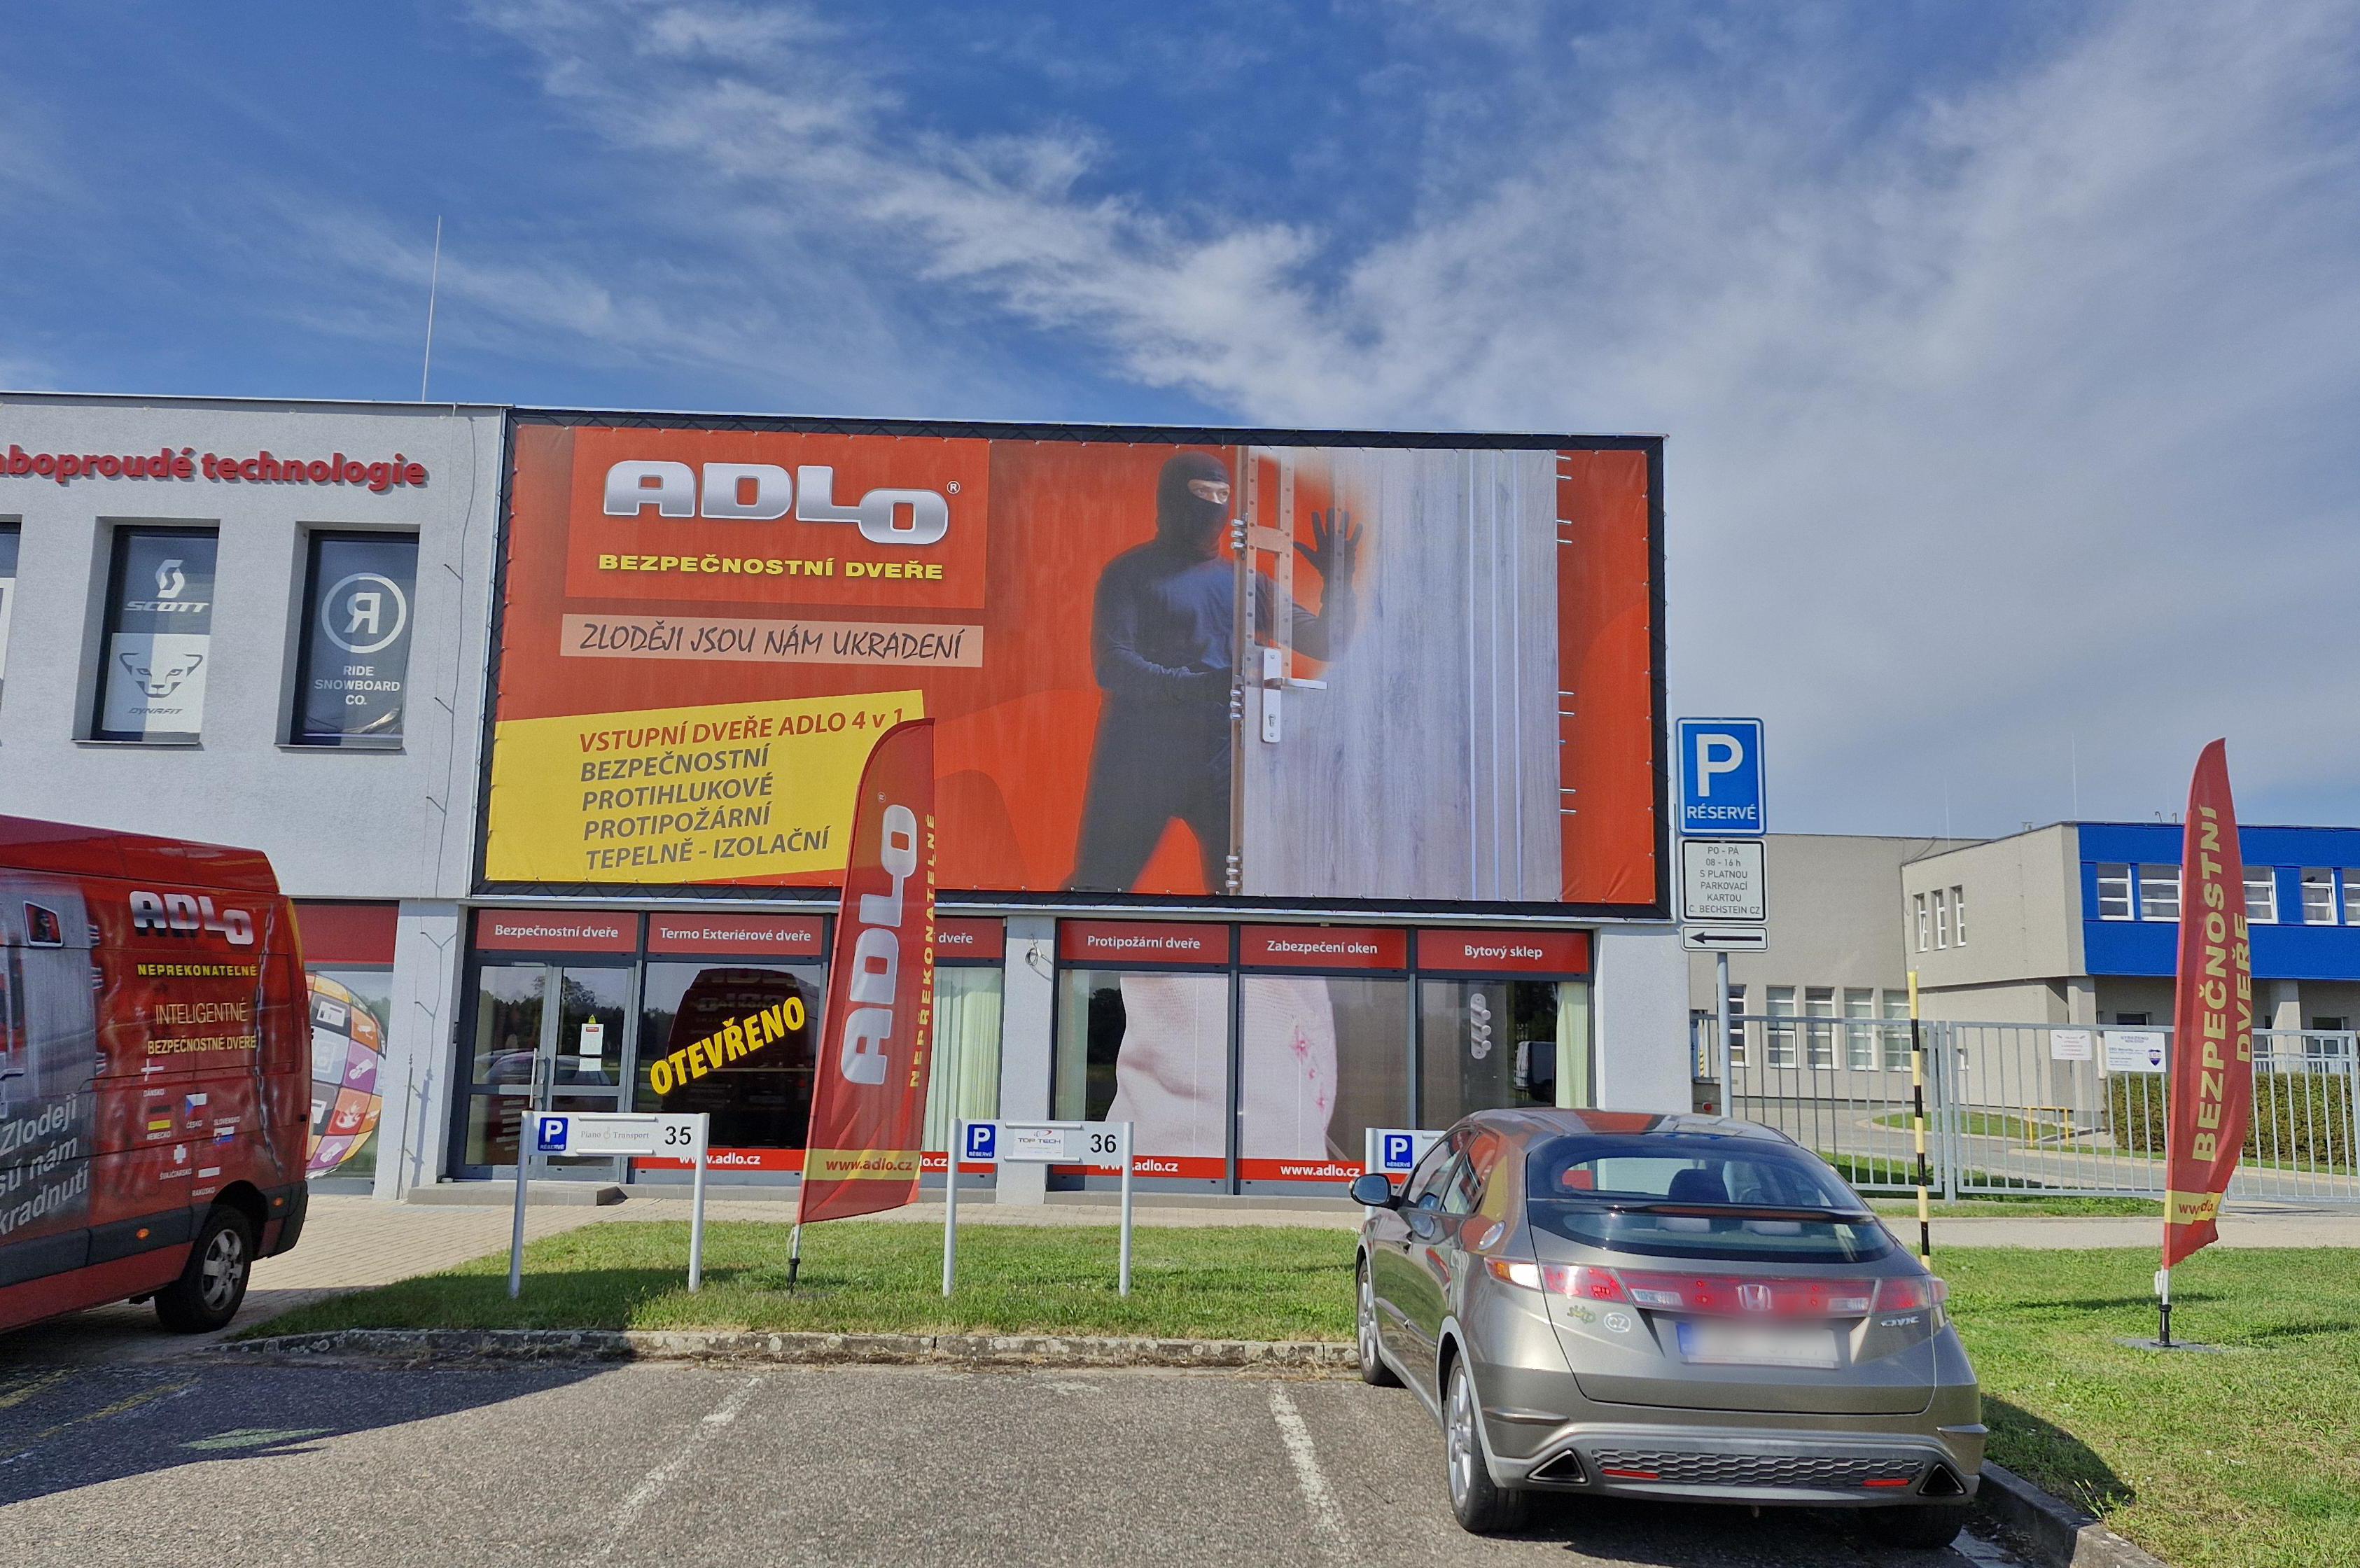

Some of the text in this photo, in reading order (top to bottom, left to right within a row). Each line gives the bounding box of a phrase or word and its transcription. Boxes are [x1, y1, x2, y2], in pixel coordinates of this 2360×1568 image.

[201, 450, 426, 491] technologie
[603, 460, 948, 545] ADLO
[599, 554, 943, 580] BEZPEČNOSTNÍ DVEŘE
[124, 601, 209, 612] SCOTT
[579, 621, 966, 660] ZLODĚJI JSOU NÁM UKRADENÍ
[343, 666, 375, 676] RIDE
[314, 679, 400, 691] SNOWBOARD
[345, 694, 367, 705] CO.
[579, 708, 903, 752] VSTUPNÍ DVEŘE ADLO 4 v 1
[580, 743, 771, 782] BEZPEČNOSTNÍ
[1696, 734, 1743, 797] P
[582, 772, 774, 811] PROTIHLUKOVÉ
[584, 802, 772, 840] PROTIPOŽÁRNÍ
[1687, 804, 1757, 820] RÉSERVÉ
[586, 838, 693, 869] TEPELNĚ
[713, 825, 832, 859] IZOLAČNÍ
[1728, 846, 1739, 855] PÁ
[1725, 858, 1733, 867] 16
[1708, 870, 1748, 878] PLATNOU
[1701, 880, 1747, 890] PARKOVACÍ
[1707, 894, 1741, 902] KARTOU
[129, 890, 254, 945] ADLO
[1700, 905, 1747, 913] BECHSTEIN
[1750, 906, 1761, 914] CZ
[495, 924, 619, 938] Bezpečnostní dveře
[660, 927, 811, 941] Termo Exteriérové dveře
[938, 932, 973, 944] dveře
[841, 805, 916, 1084] ADLO
[1087, 935, 1201, 950] Protipožární dveře
[1267, 940, 1378, 954] Zabezpečení oken
[1465, 945, 1543, 958] Bytový sklep
[2192, 804, 2227, 1162] BEZPEČNOSTNÍ
[2233, 913, 2251, 1063] DVEŘE
[155, 997, 247, 1024] INTELIGENTNÉ
[147, 1033, 224, 1055] BEZPEČNOSTNÉ
[650, 996, 805, 1094] OTEVŘENO
[0, 1093, 77, 1155] Zlodeji
[545, 1120, 563, 1142] P
[613, 1131, 650, 1140] Transport
[665, 1126, 692, 1145] 35
[973, 1128, 991, 1149] P
[1089, 1133, 1117, 1153] 36
[1390, 1138, 1408, 1160] P
[29, 1138, 77, 1180] nám
[826, 1157, 913, 1171] www.adlo.cz
[1280, 1164, 1360, 1177] www.adlo.cz
[1607, 1316, 1625, 1329] CZ
[1880, 1316, 1919, 1327] CIVIC
